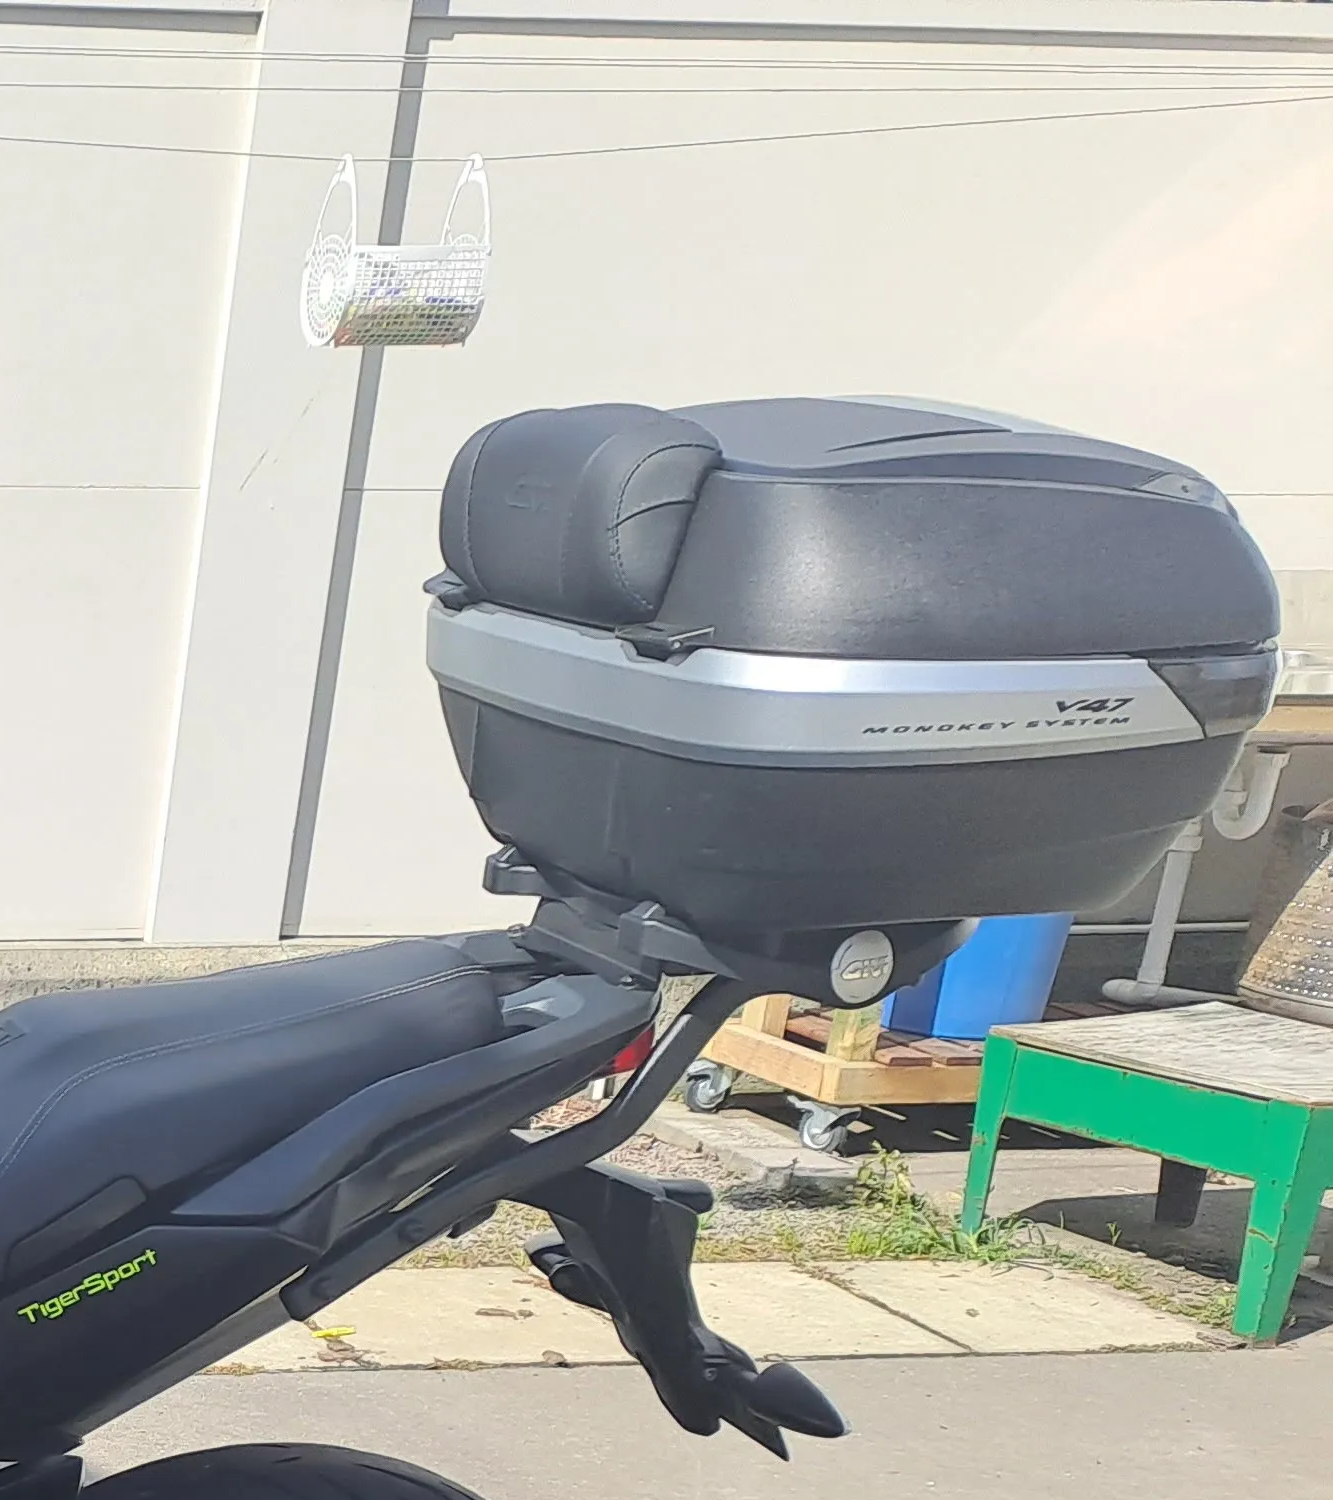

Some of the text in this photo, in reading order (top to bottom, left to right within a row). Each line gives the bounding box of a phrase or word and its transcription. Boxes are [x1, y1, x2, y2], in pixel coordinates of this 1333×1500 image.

[1055, 696, 1135, 714] V47
[861, 716, 1131, 735] MONOKEY SYSTEM
[16, 1248, 158, 1323] TigerSport
